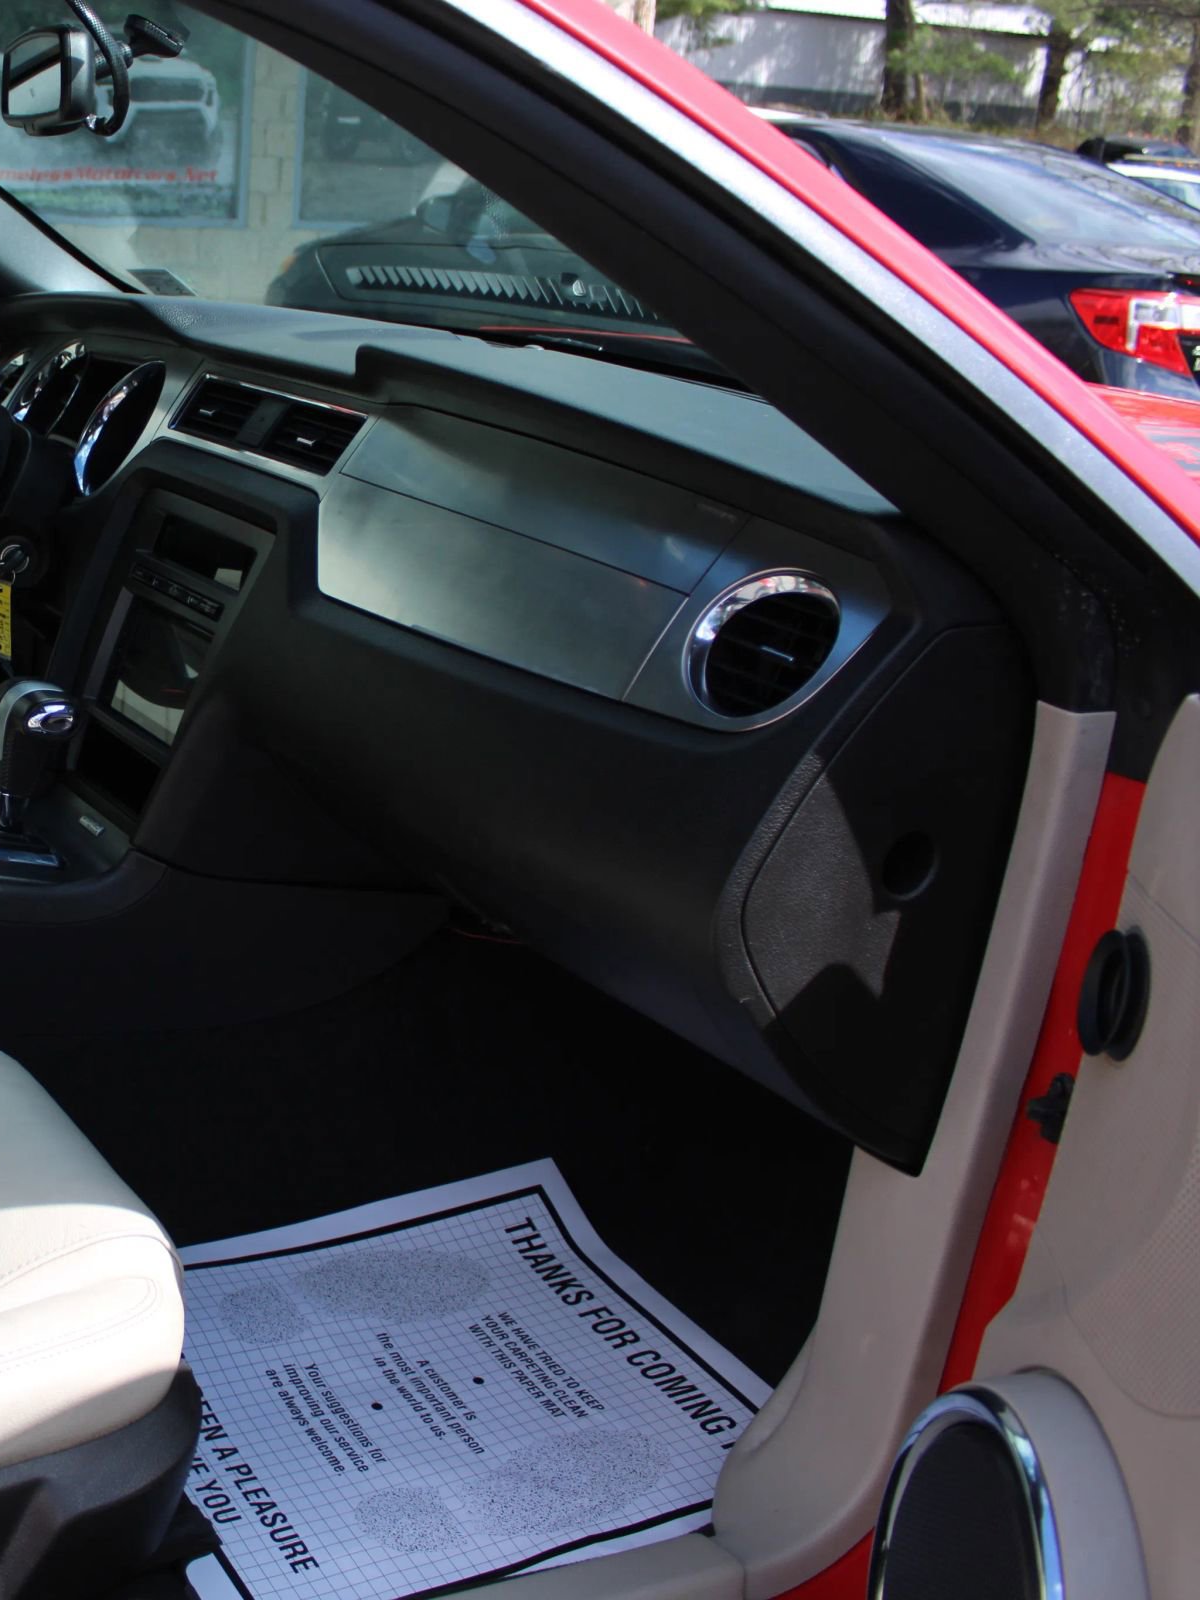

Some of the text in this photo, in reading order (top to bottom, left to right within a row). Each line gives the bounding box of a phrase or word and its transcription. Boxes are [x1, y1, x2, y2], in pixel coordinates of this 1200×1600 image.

[468, 1323, 567, 1418] WITH THIS PAPER MAT
[481, 1314, 589, 1418] YOUR CARPETING CLEAN
[497, 1311, 606, 1411] WE HAVE TRIED TO KEEP
[504, 1216, 737, 1435] THANKS FOR COMING
[265, 1369, 345, 1476] are always welcome.
[283, 1363, 369, 1473] improving our service
[304, 1363, 387, 1463] Your suggestions for
[373, 1357, 447, 1440] in the world to us.
[376, 1332, 485, 1455] the most important person
[416, 1360, 477, 1421] A customer is
[195, 1479, 242, 1524] YOU
[211, 1447, 239, 1461] A
[224, 1463, 320, 1574] PLEASURE
